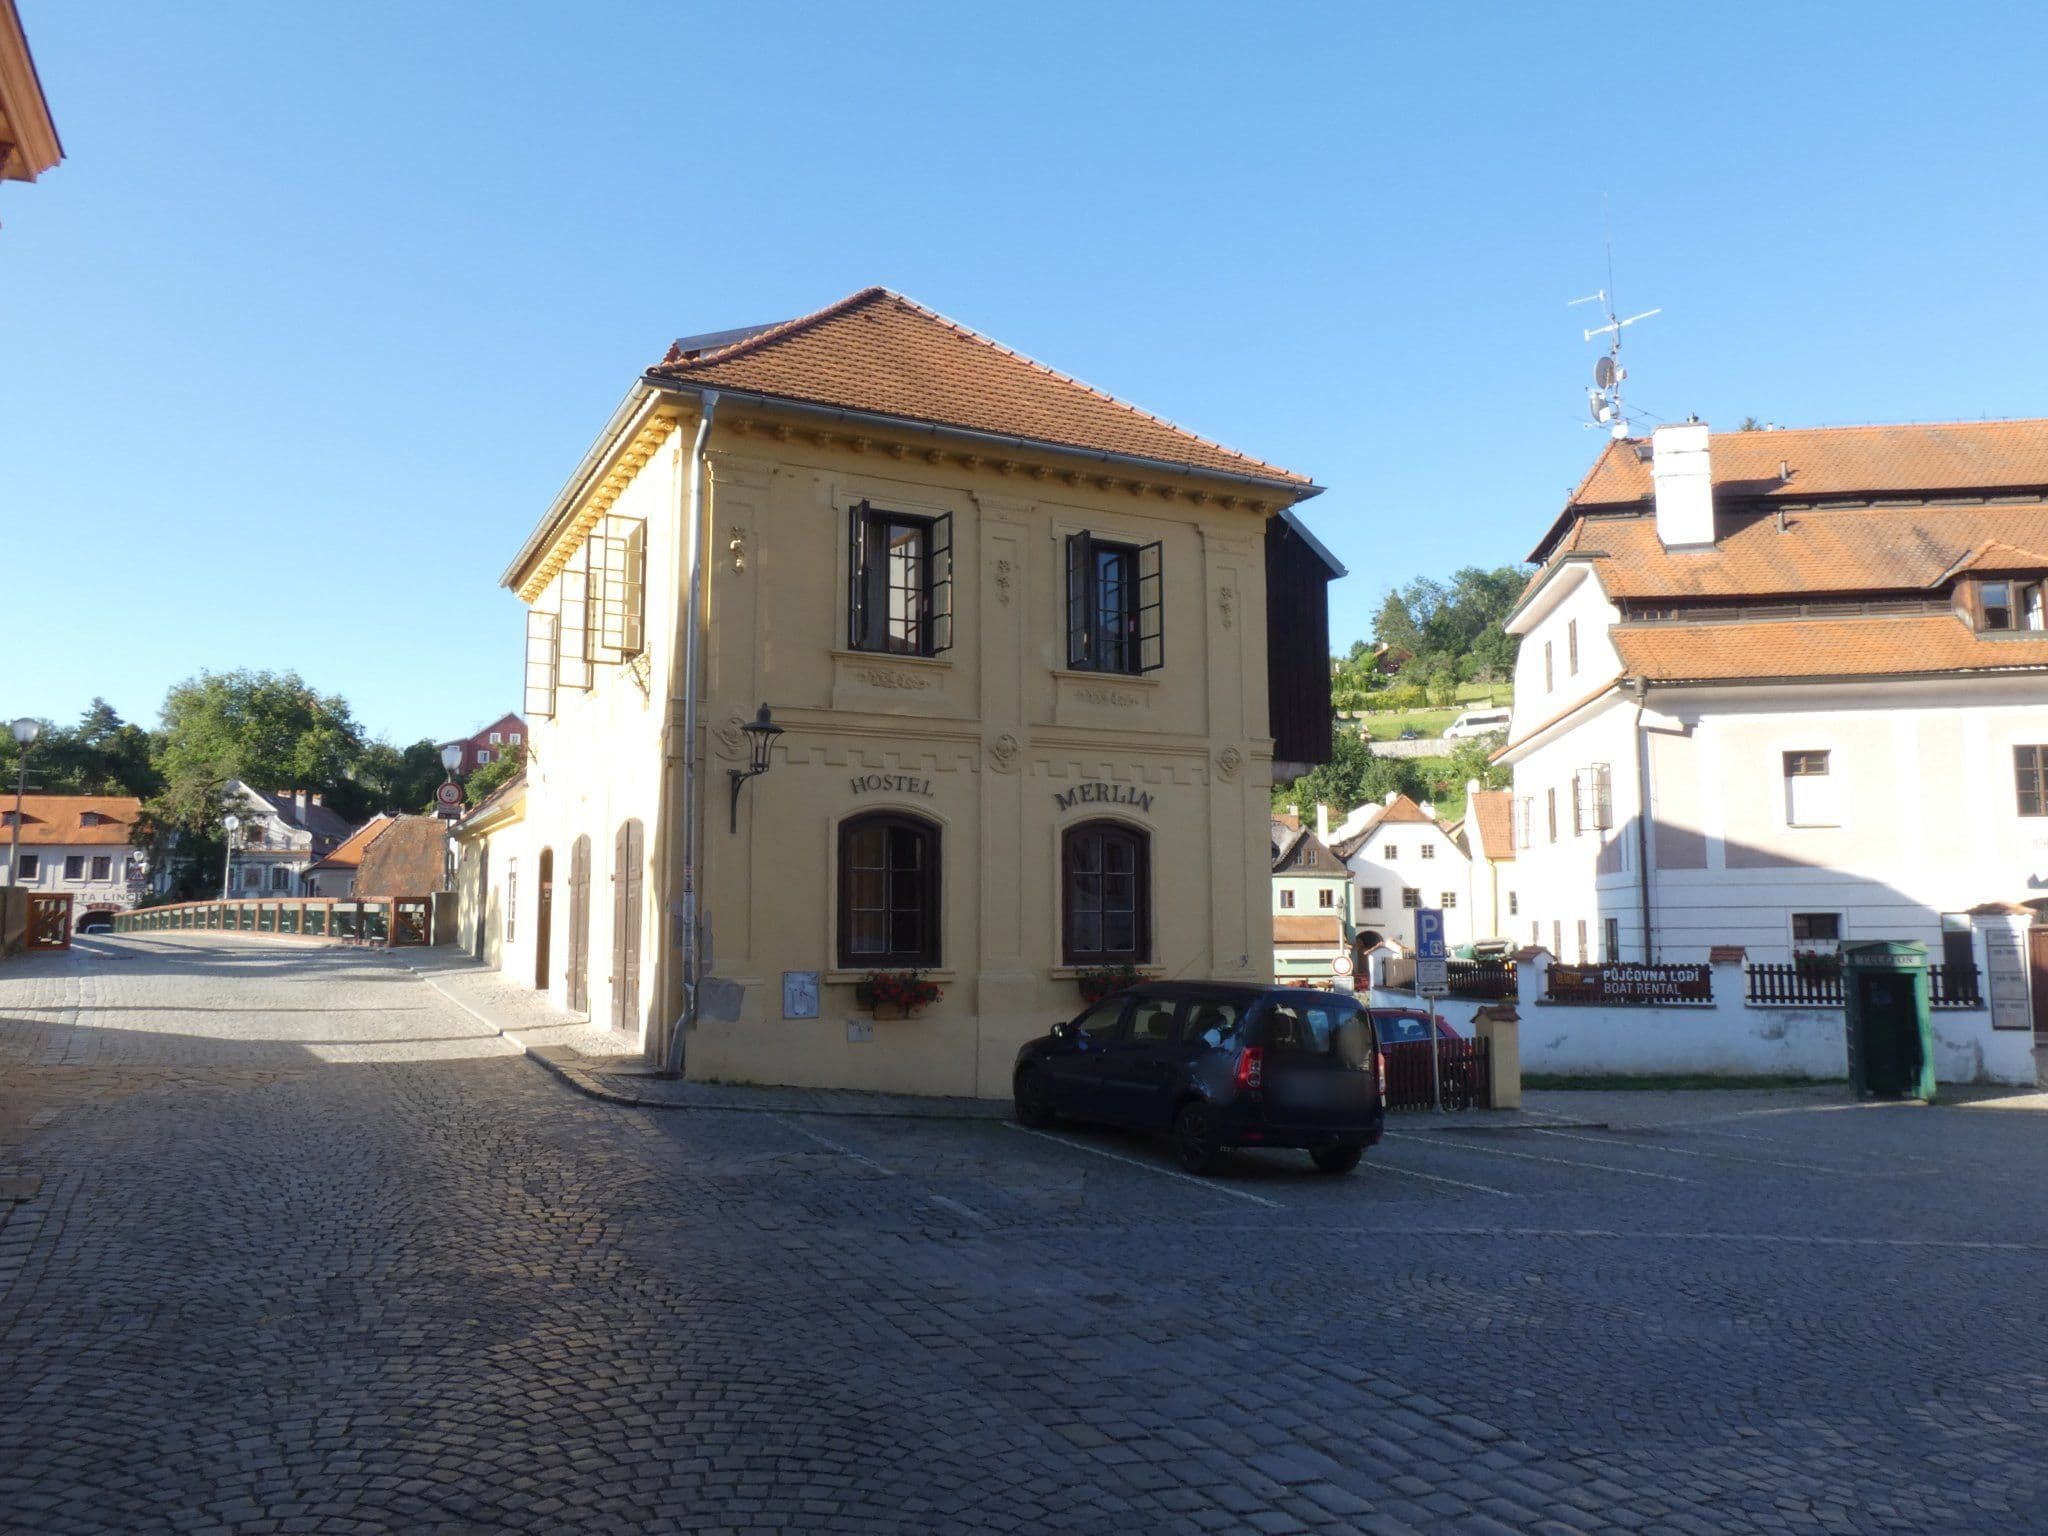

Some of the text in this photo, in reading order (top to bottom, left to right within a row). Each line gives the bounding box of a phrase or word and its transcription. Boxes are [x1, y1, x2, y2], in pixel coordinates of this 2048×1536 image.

[850, 774, 934, 796] HOSTEL
[1055, 783, 1154, 812] MERLIN
[1422, 915, 1438, 943] P
[1603, 967, 1699, 982] PŮJČOVNA LODÍ
[1604, 983, 1681, 995] BOAT RENTAL
